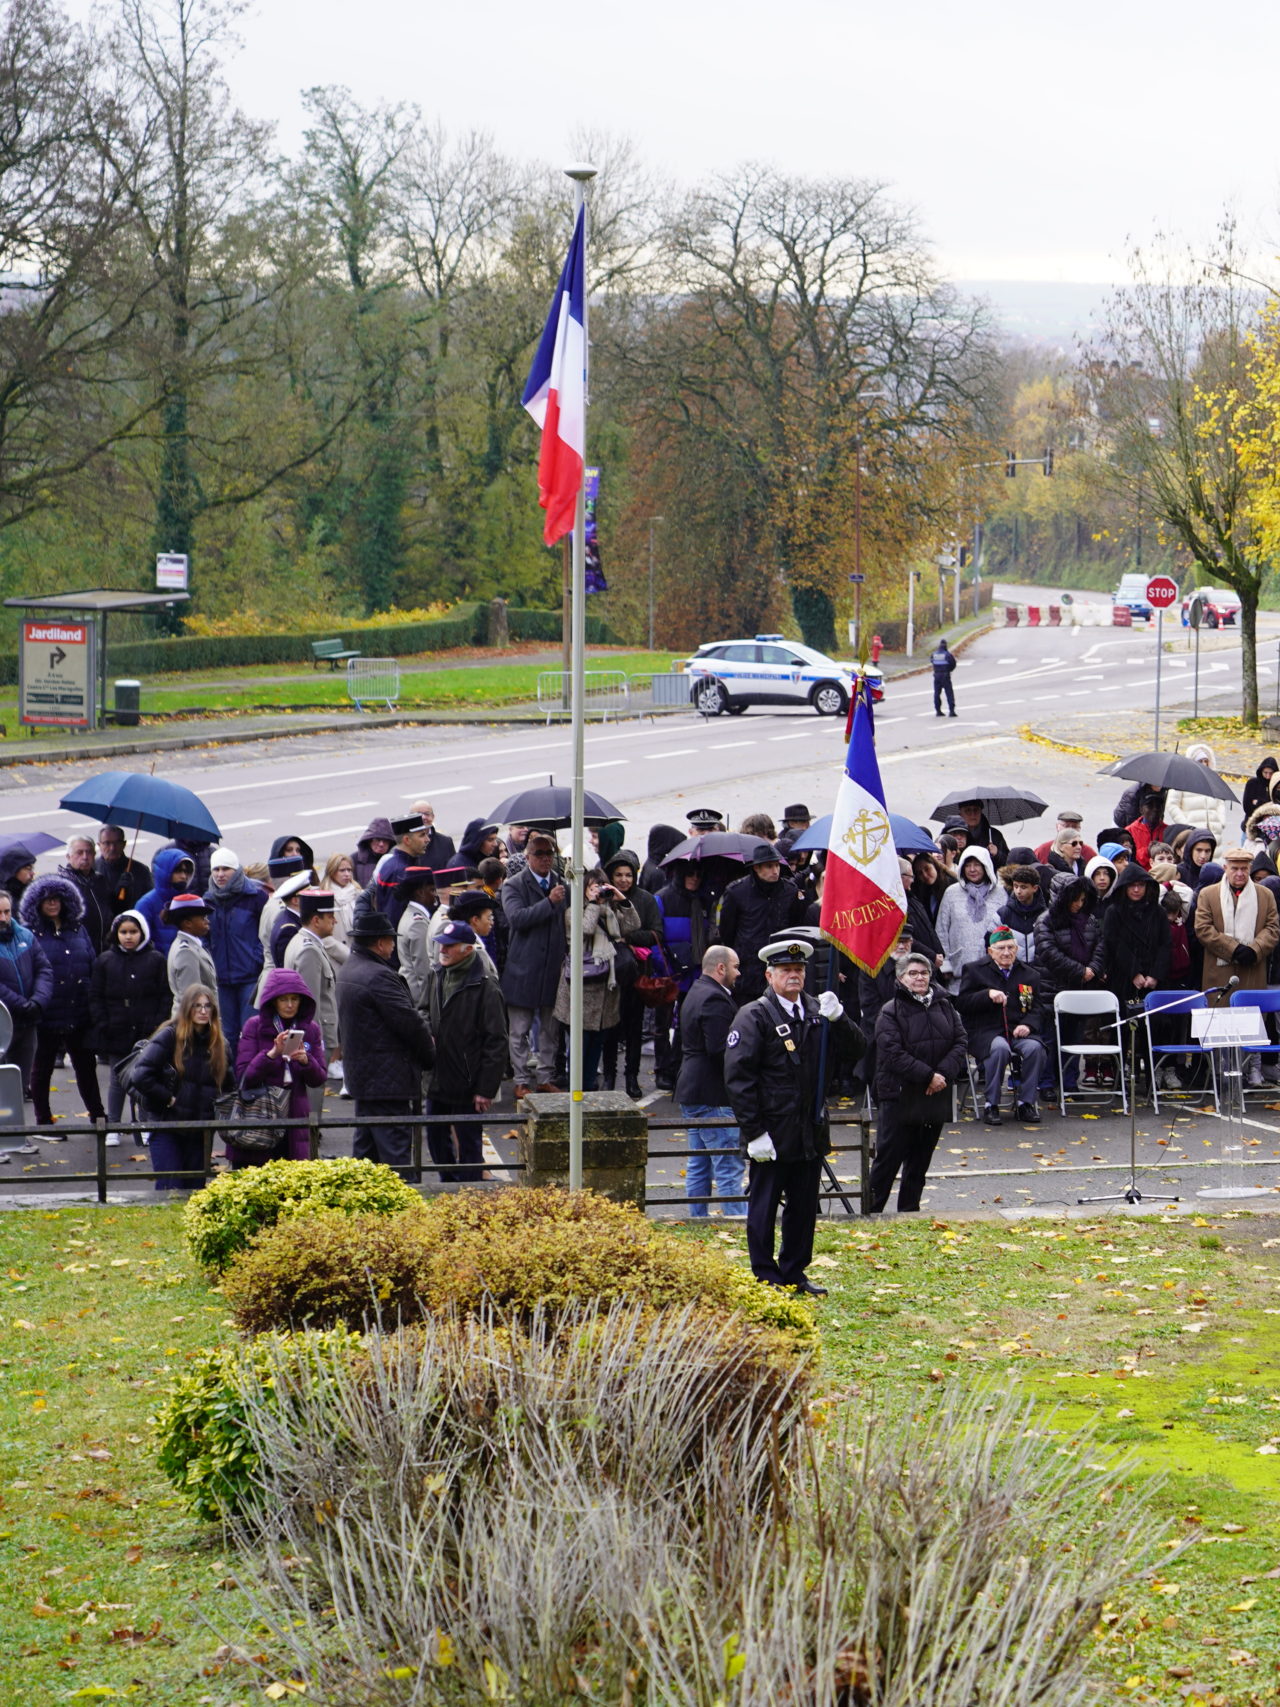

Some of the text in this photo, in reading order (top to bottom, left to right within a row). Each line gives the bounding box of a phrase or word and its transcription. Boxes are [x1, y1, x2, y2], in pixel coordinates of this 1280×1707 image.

[1148, 587, 1175, 598] STOP
[29, 627, 82, 641] Jardiland
[829, 894, 897, 930] ANCIENS
